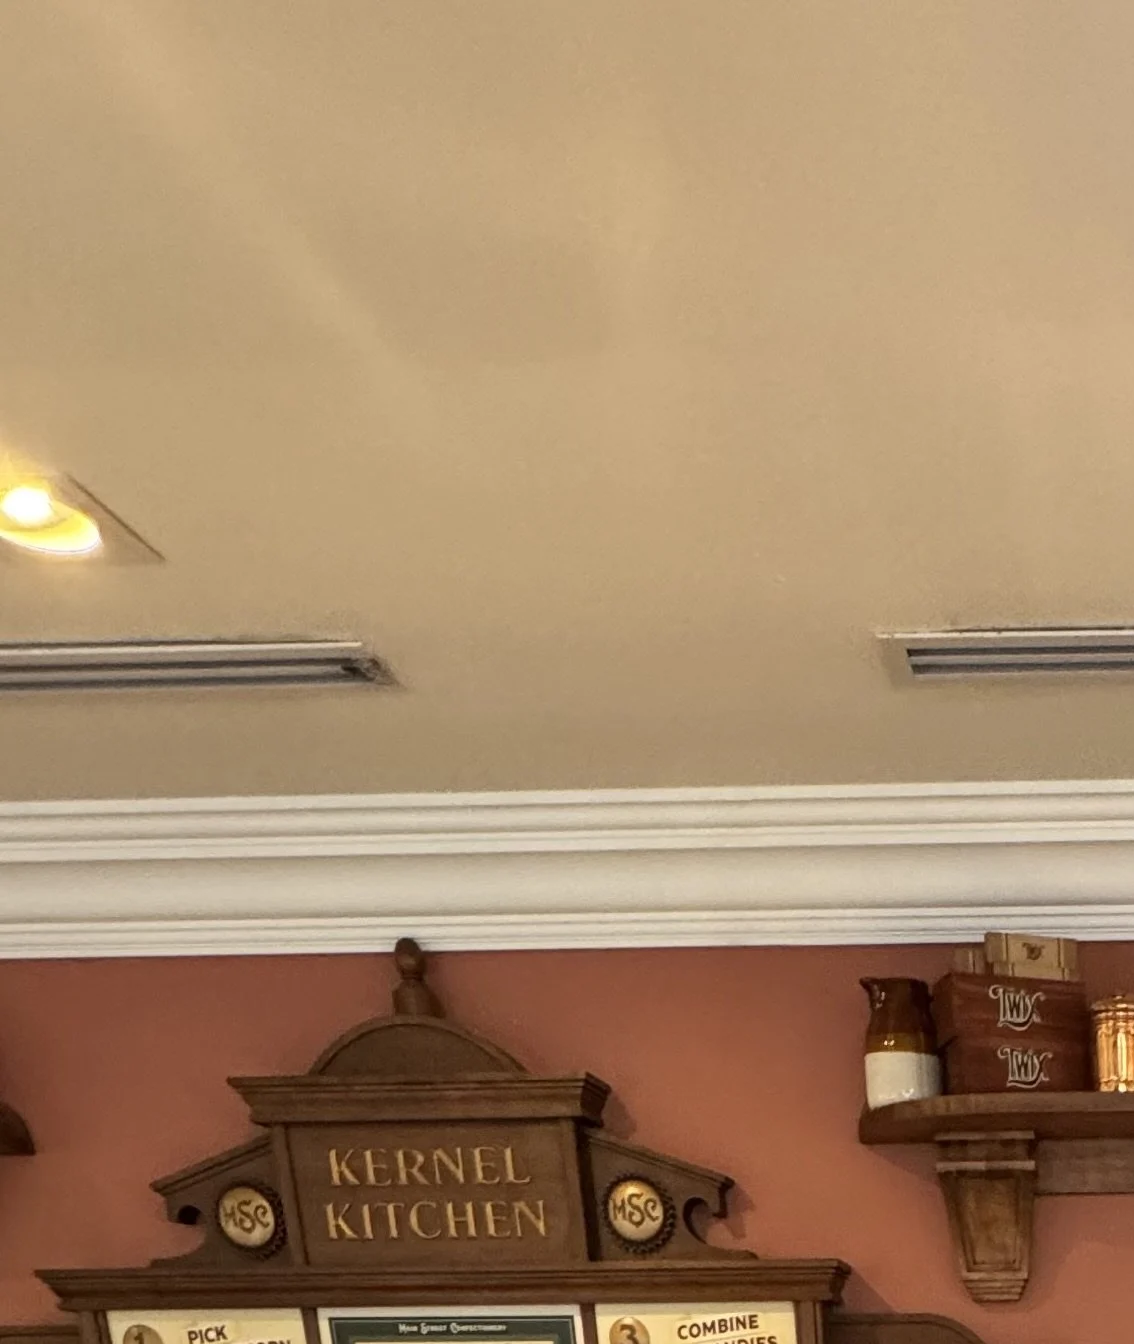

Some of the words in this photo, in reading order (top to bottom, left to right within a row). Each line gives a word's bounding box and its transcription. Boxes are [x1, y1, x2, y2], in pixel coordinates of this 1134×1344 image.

[328, 1145, 532, 1187] KERNEL
[325, 1199, 548, 1240] KITCHEN
[677, 1313, 760, 1341] COMBINE
